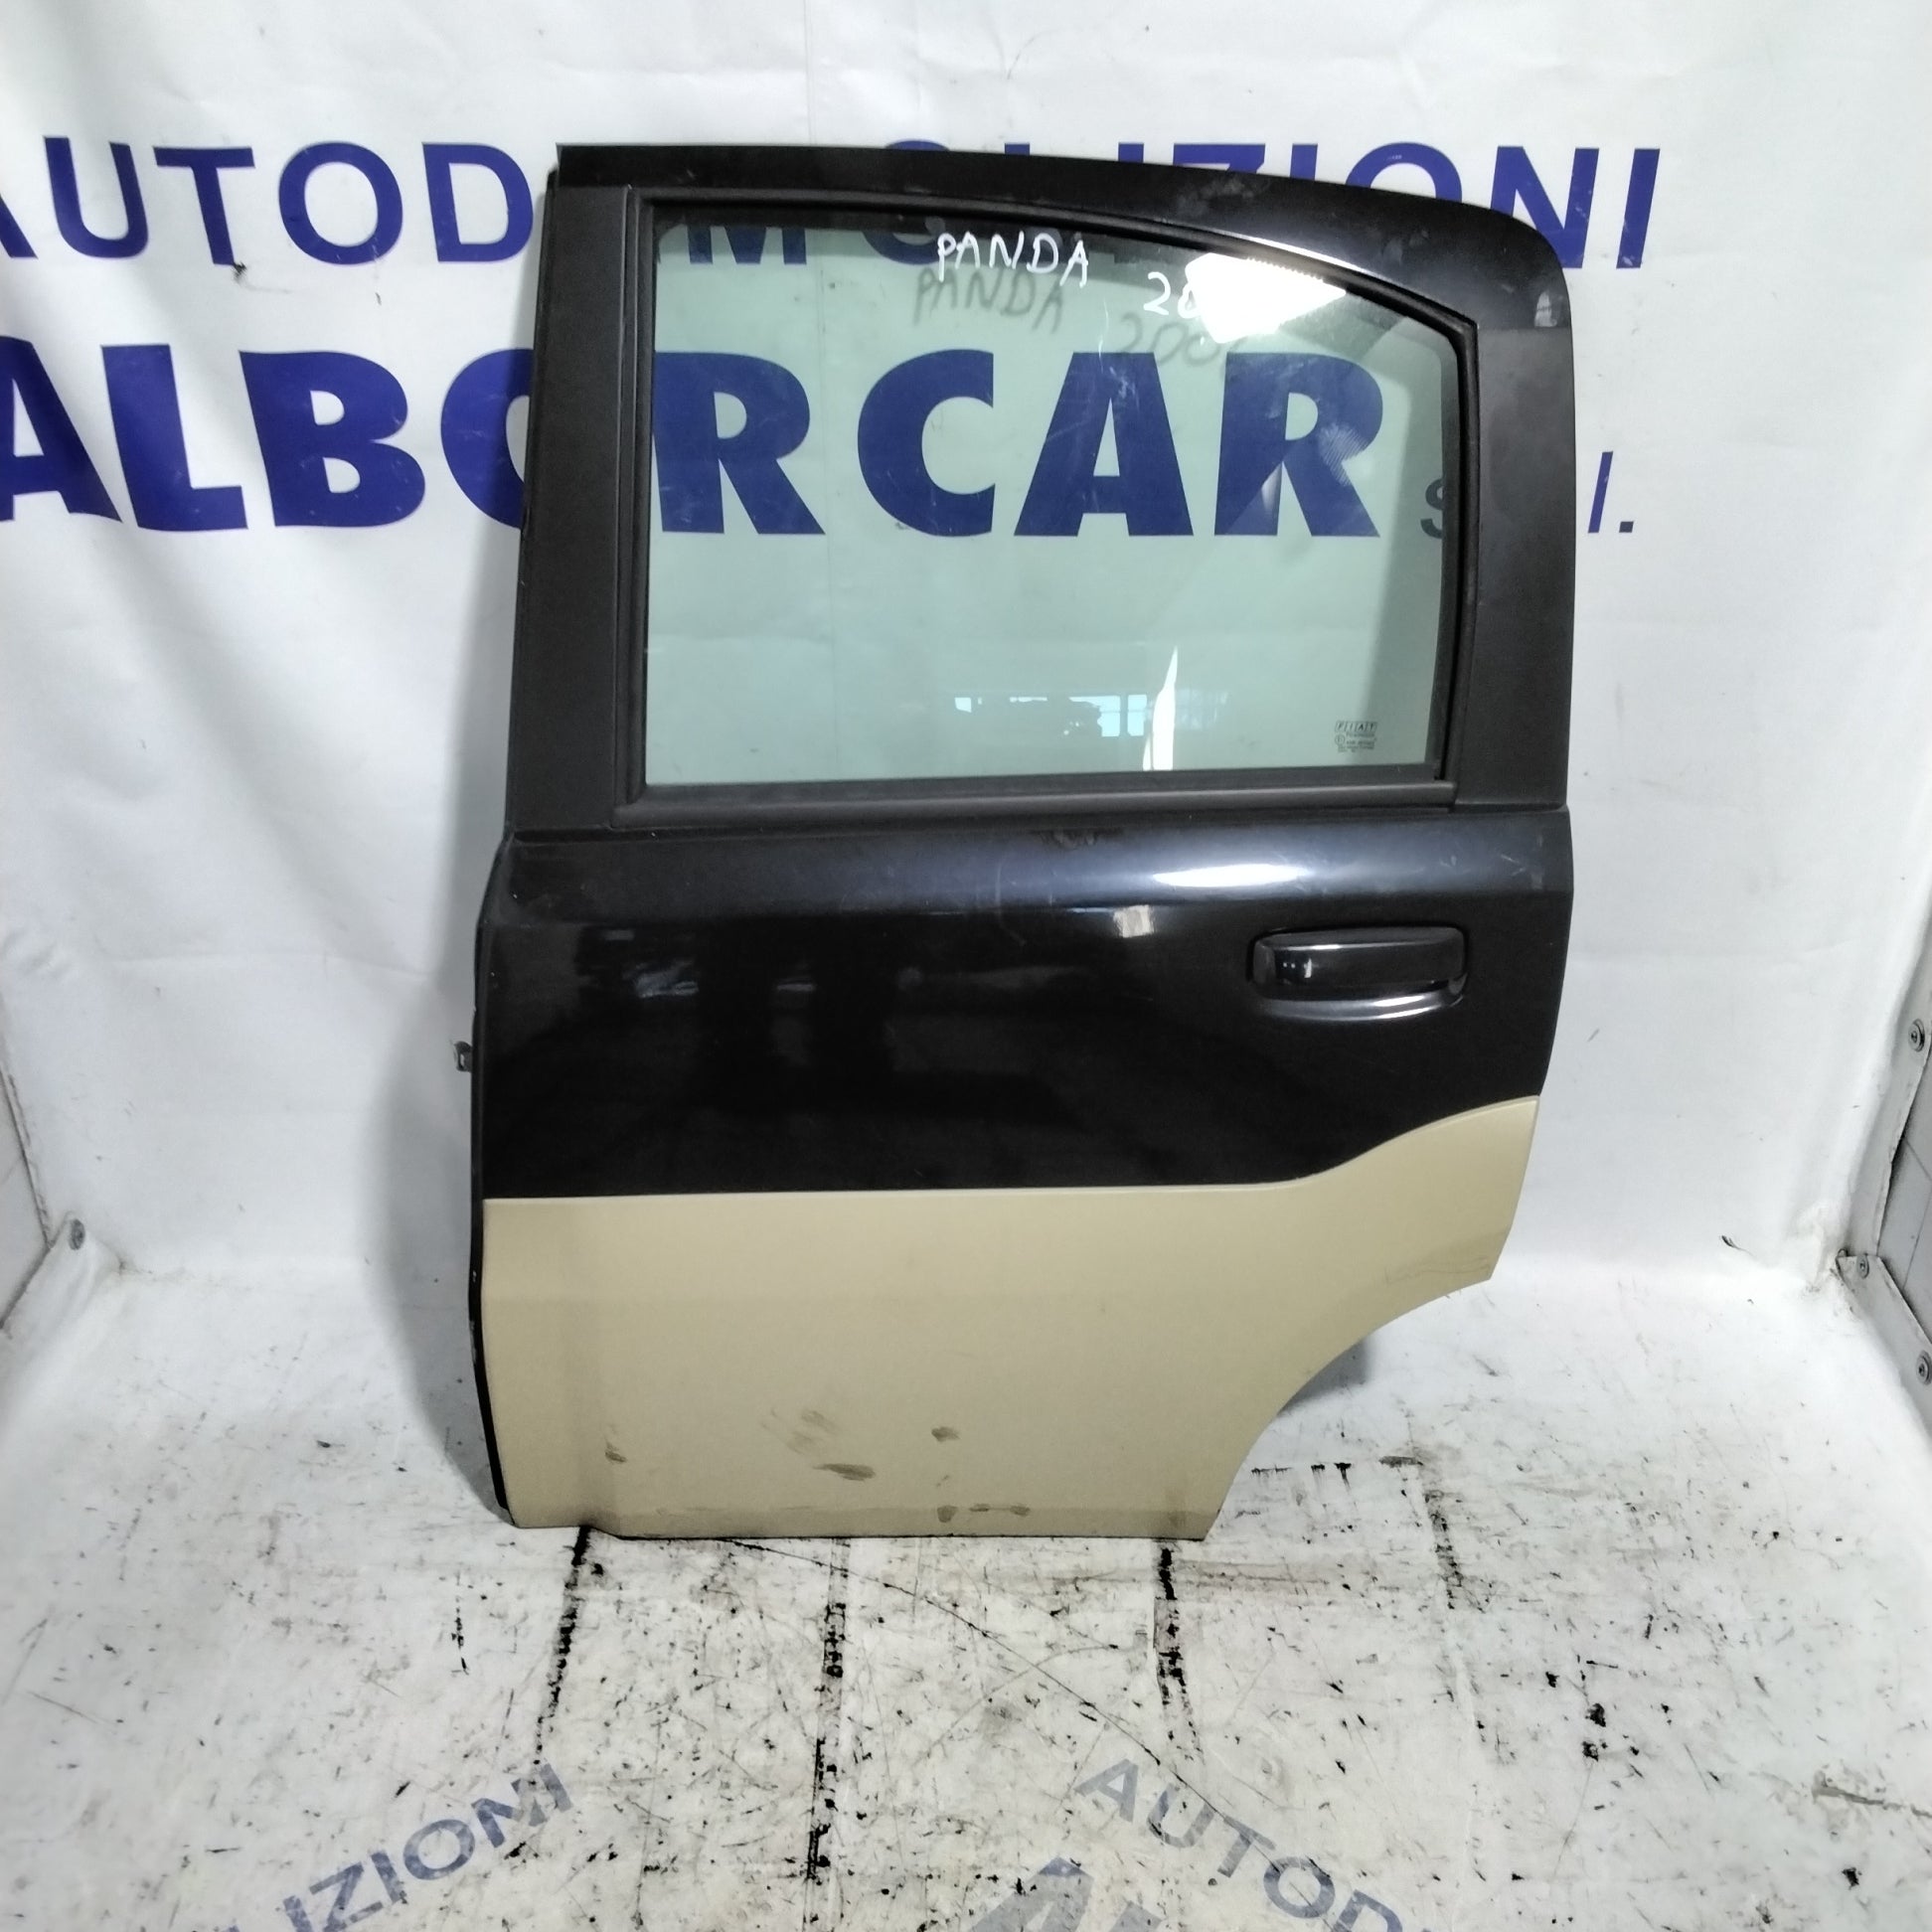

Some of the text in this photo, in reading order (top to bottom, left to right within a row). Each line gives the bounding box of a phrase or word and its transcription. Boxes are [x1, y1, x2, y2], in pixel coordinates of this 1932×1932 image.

[937, 231, 1088, 288] PANDA
[224, 1763, 573, 1932] IZIONI
[1074, 1758, 1431, 1932] AUTOD
